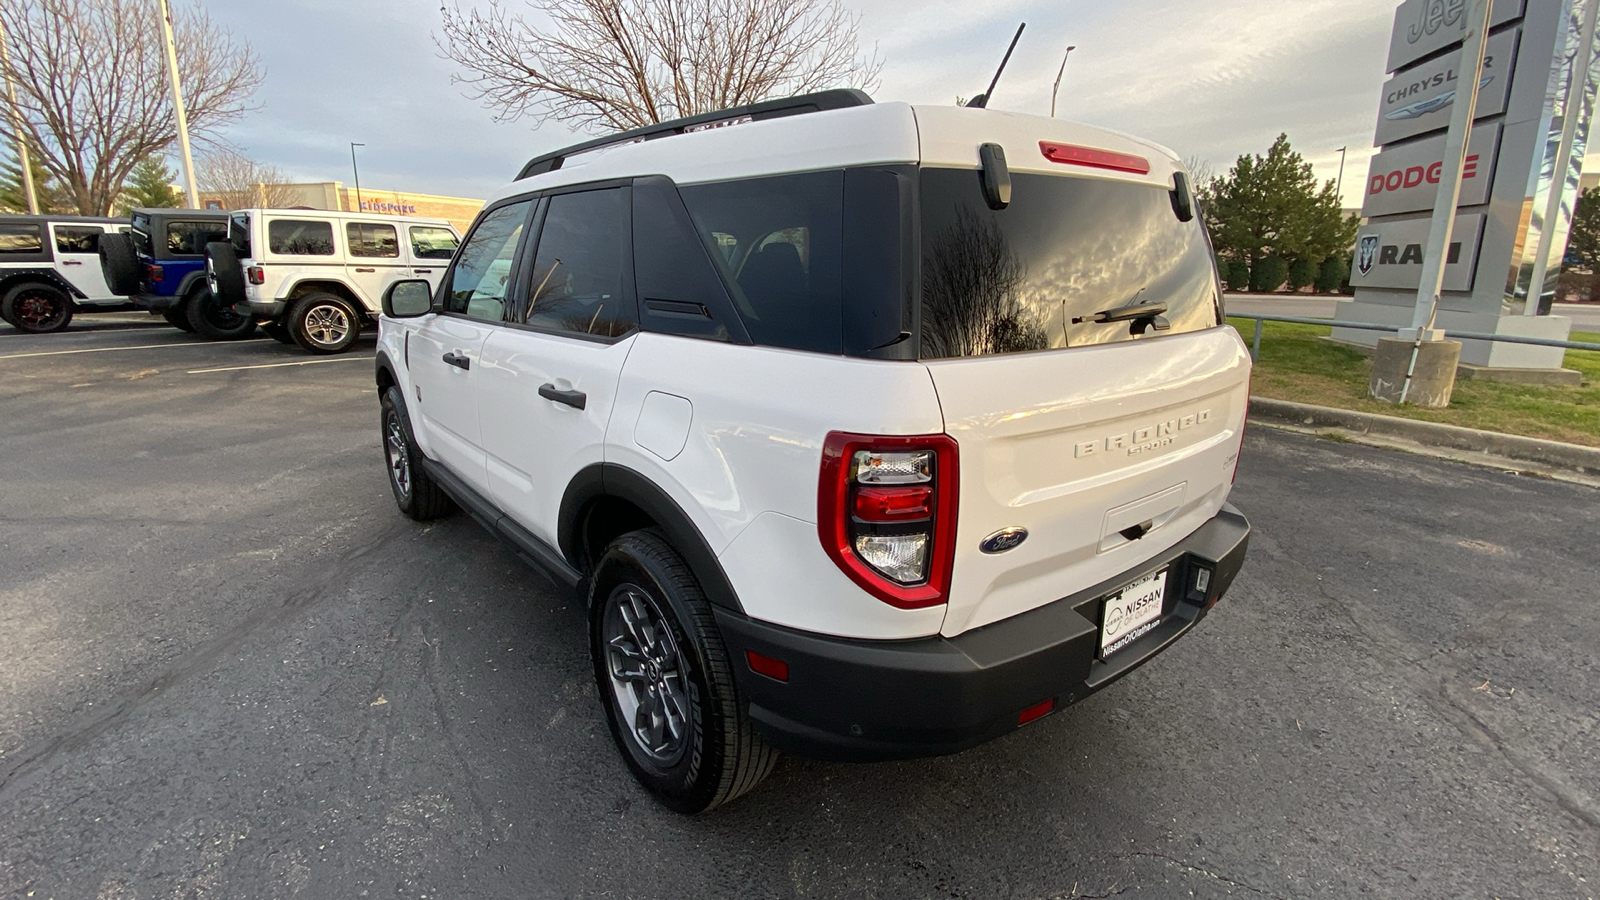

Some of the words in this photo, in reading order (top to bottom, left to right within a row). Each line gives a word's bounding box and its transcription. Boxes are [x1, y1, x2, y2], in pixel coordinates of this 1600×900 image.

[1406, 0, 1467, 44] Jee
[1386, 55, 1494, 105] CHRYSLR
[1074, 409, 1211, 458] BRONCO
[1127, 435, 1178, 456] SPORT
[1123, 614, 1134, 626] OF
[1134, 600, 1160, 619] OLATHE
[1125, 587, 1162, 616] NISSAN
[1102, 619, 1160, 658] NissanOfOlathe.com
